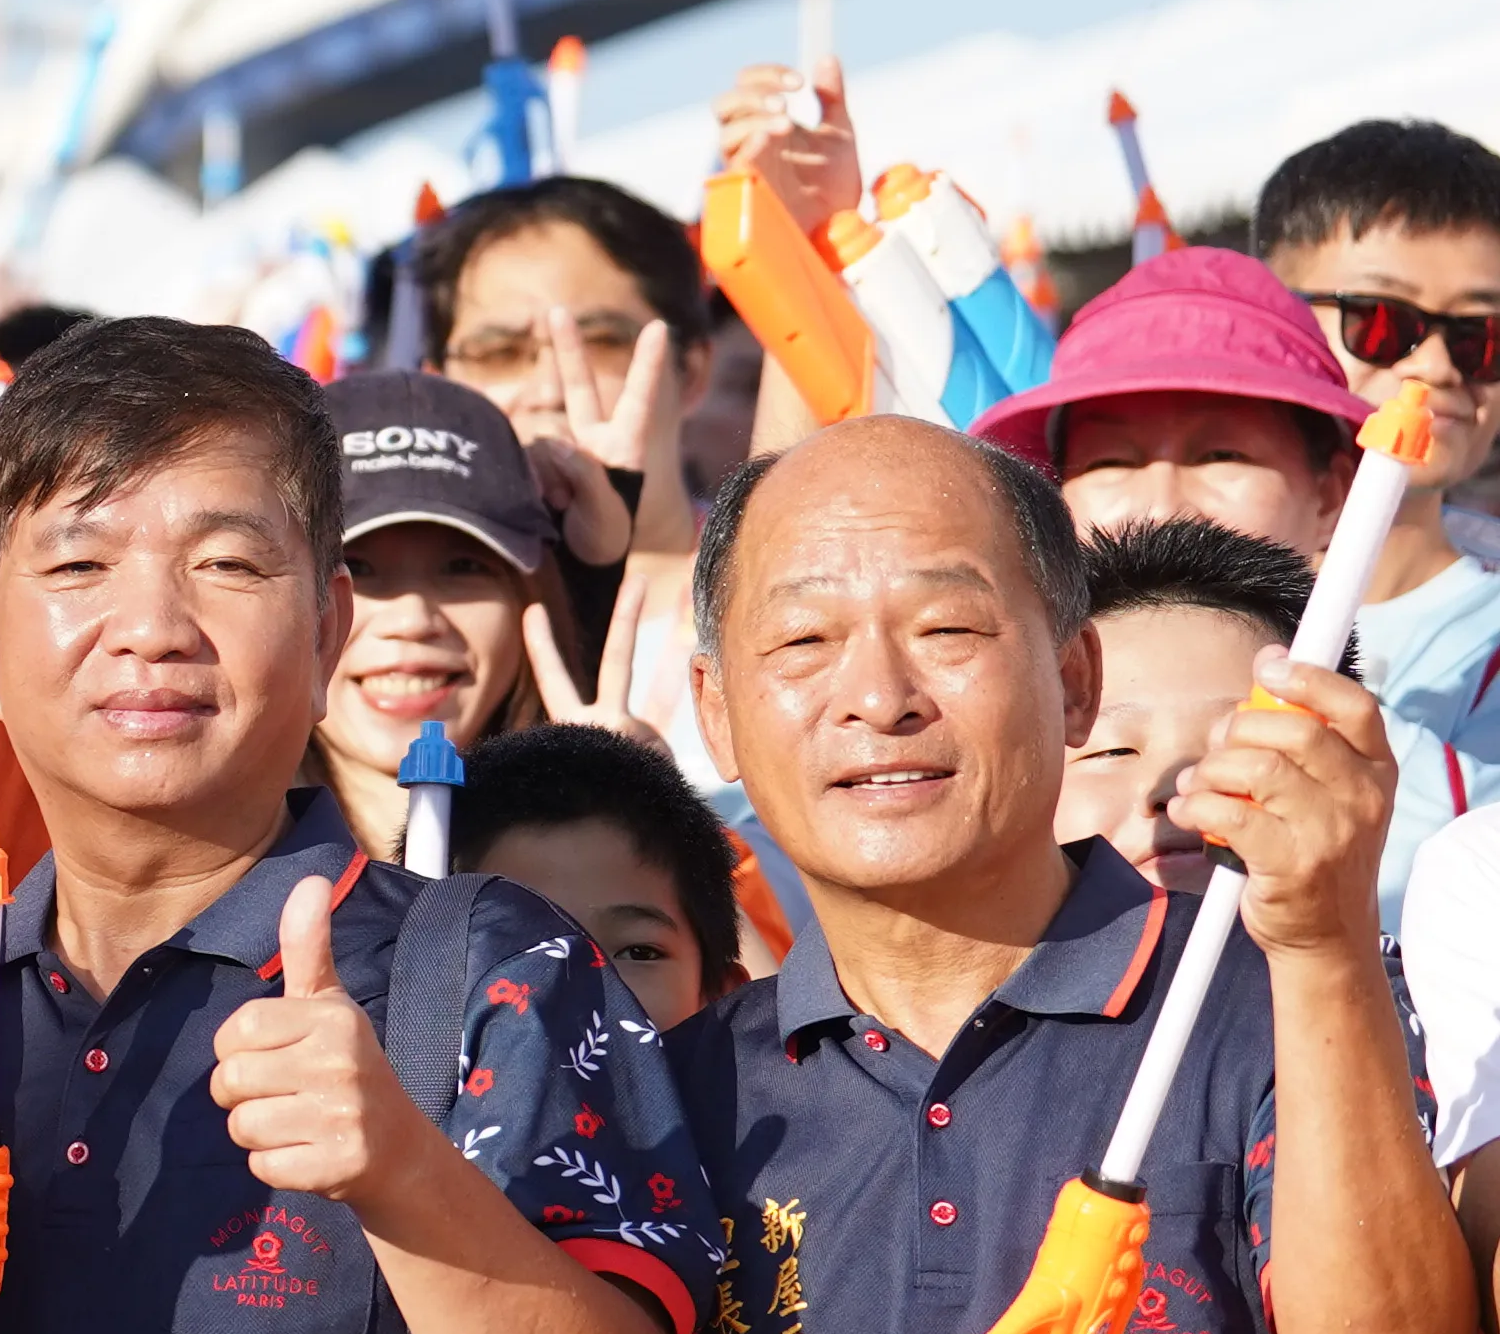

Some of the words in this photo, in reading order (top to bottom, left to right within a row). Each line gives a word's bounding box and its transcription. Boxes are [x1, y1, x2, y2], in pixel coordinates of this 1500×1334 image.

[343, 425, 478, 461] SONY
[210, 1206, 331, 1254] MONTAGUT
[213, 1274, 318, 1295] LATITUDE
[237, 1293, 285, 1308] PARIS
